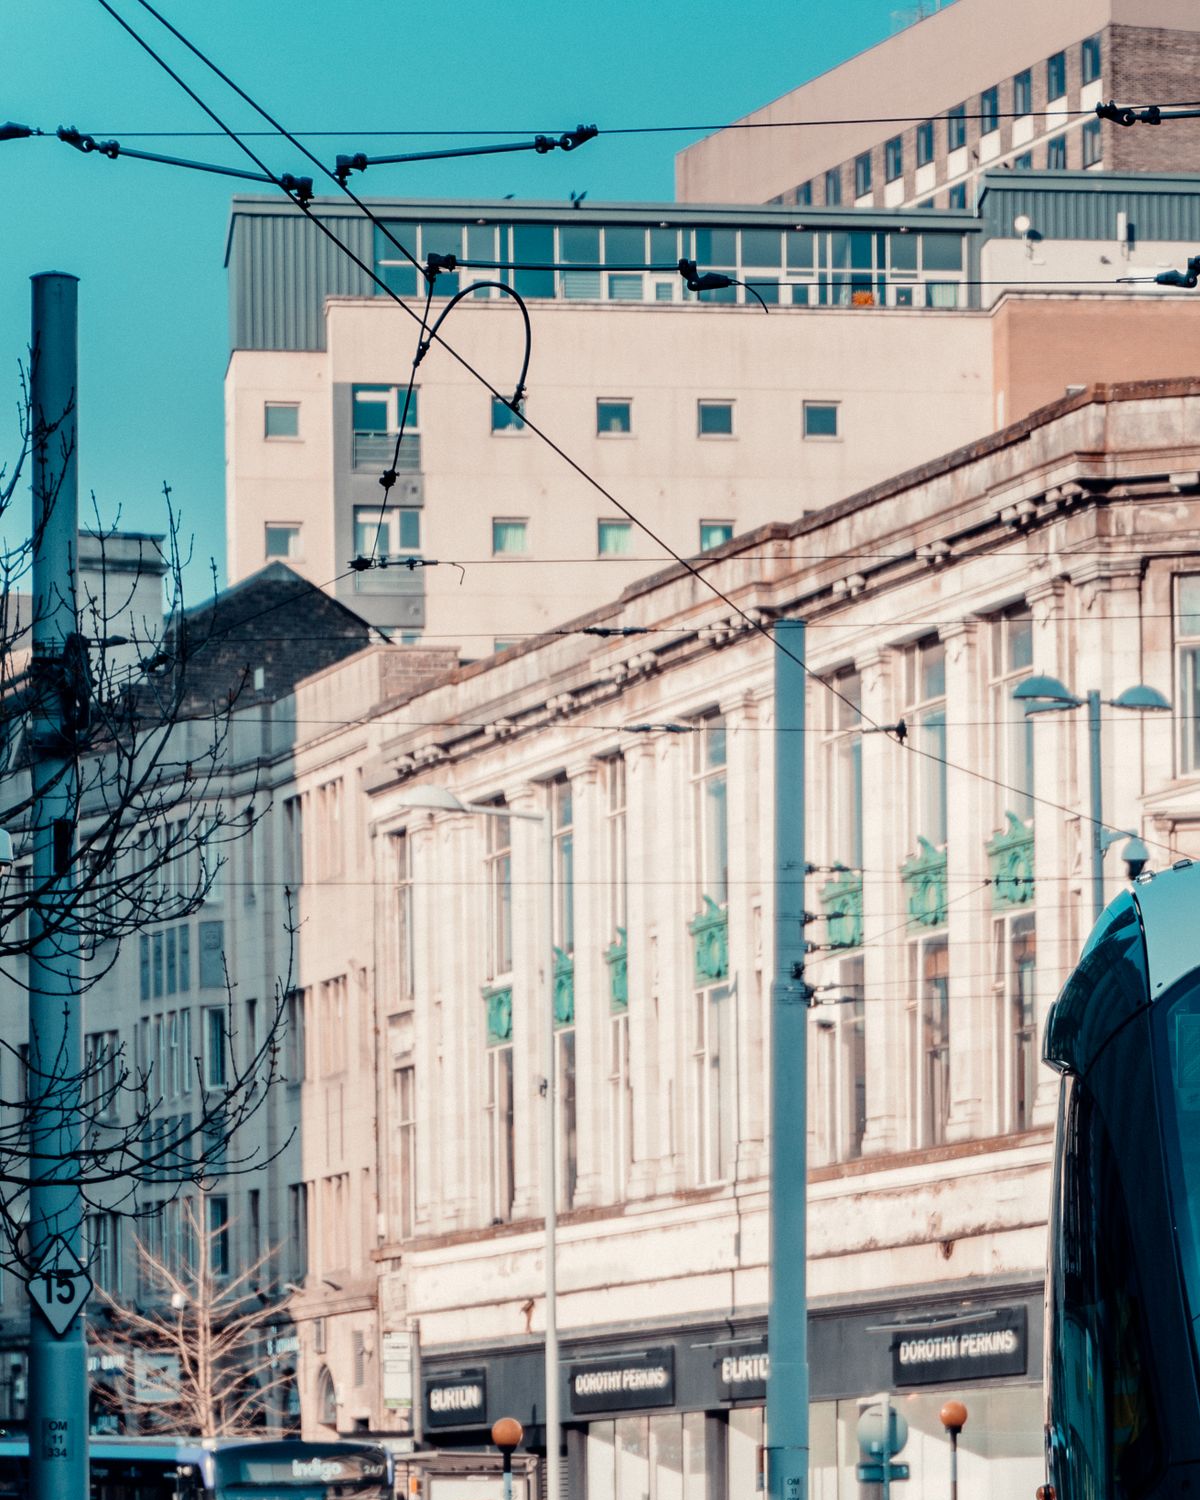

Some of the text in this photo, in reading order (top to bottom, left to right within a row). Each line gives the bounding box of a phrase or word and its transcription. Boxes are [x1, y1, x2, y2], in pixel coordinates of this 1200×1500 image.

[43, 1268, 75, 1305] 15
[900, 1329, 1017, 1365] DOROTHY PERKINS
[575, 1366, 669, 1395] DOROTHY PERKINS
[721, 1354, 770, 1383] BURTO
[430, 1385, 481, 1412] BURTON
[49, 1420, 68, 1431] OM
[52, 1434, 63, 1445] 11
[48, 1447, 67, 1458] 334
